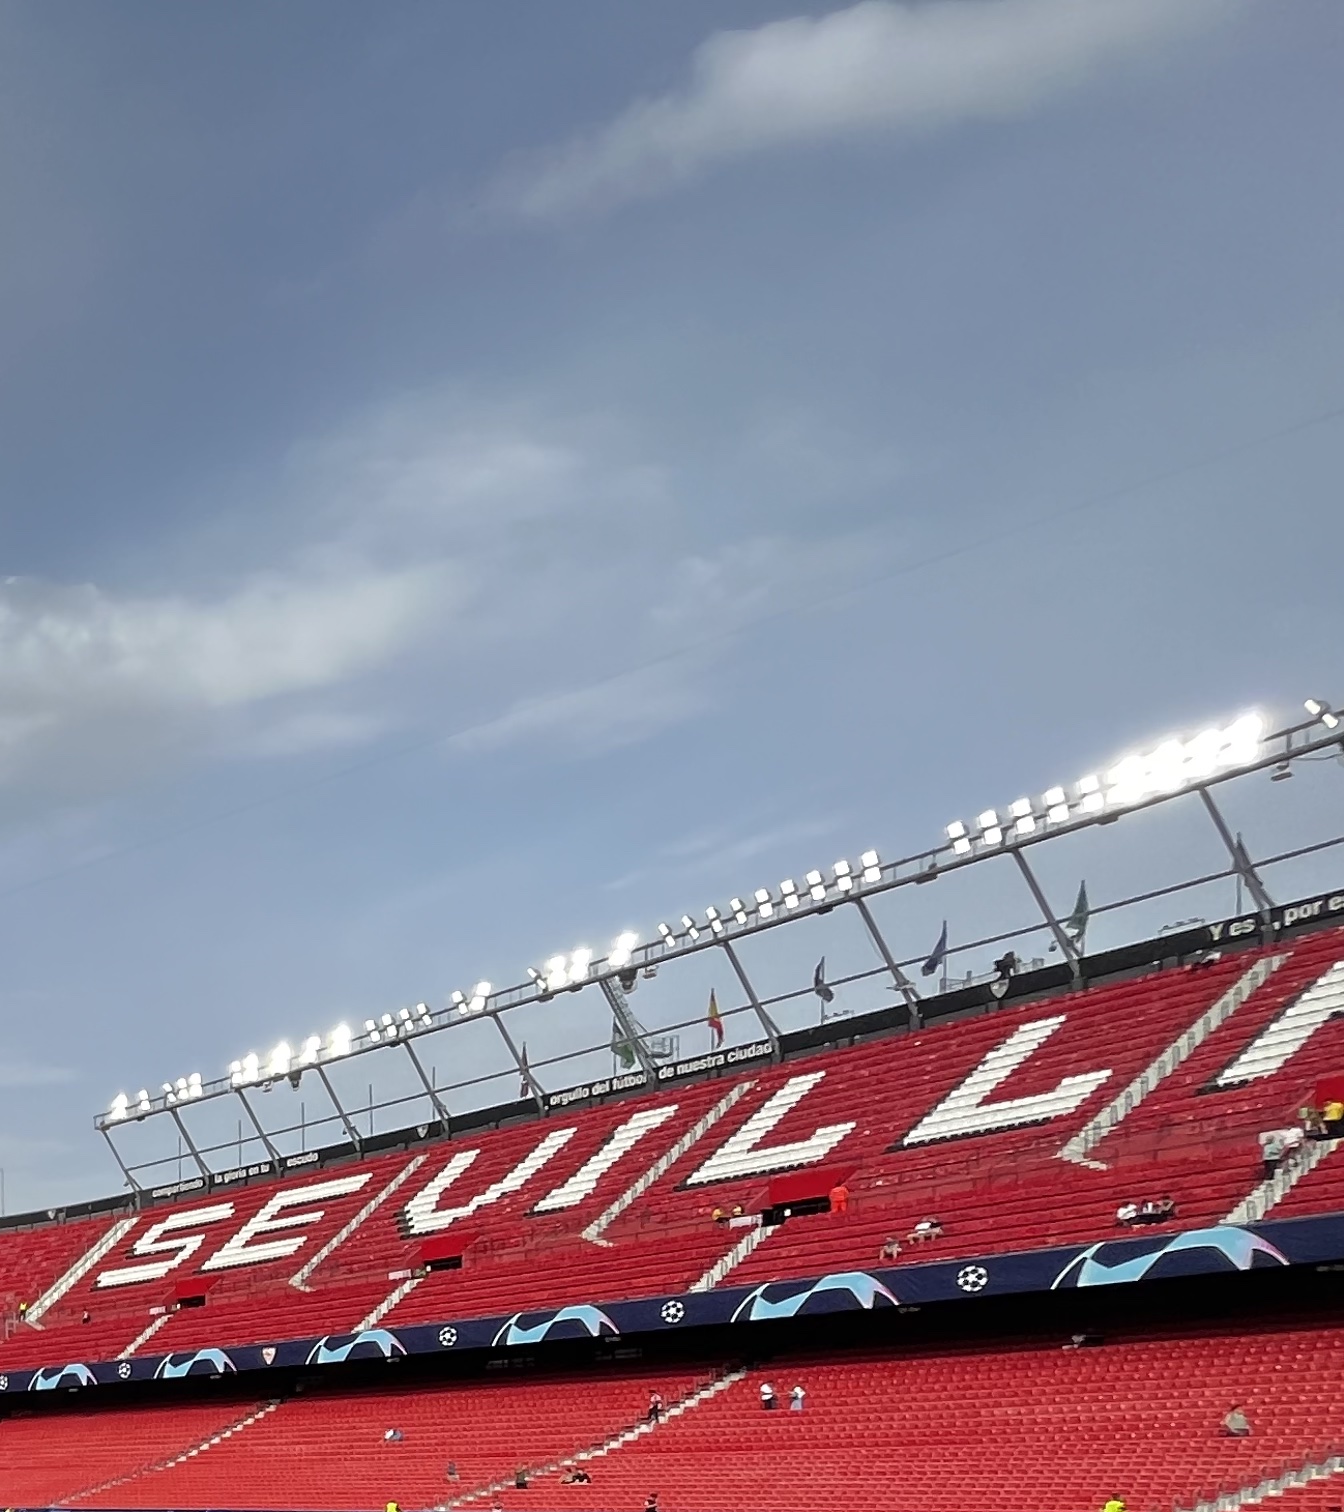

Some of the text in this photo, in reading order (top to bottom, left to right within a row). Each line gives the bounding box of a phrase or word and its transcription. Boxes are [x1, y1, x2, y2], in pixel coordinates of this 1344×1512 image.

[1284, 900, 1323, 925] por
[550, 1043, 773, 1106] orgullo del fútbol de nuestra ciudad
[287, 1152, 319, 1167] escudo
